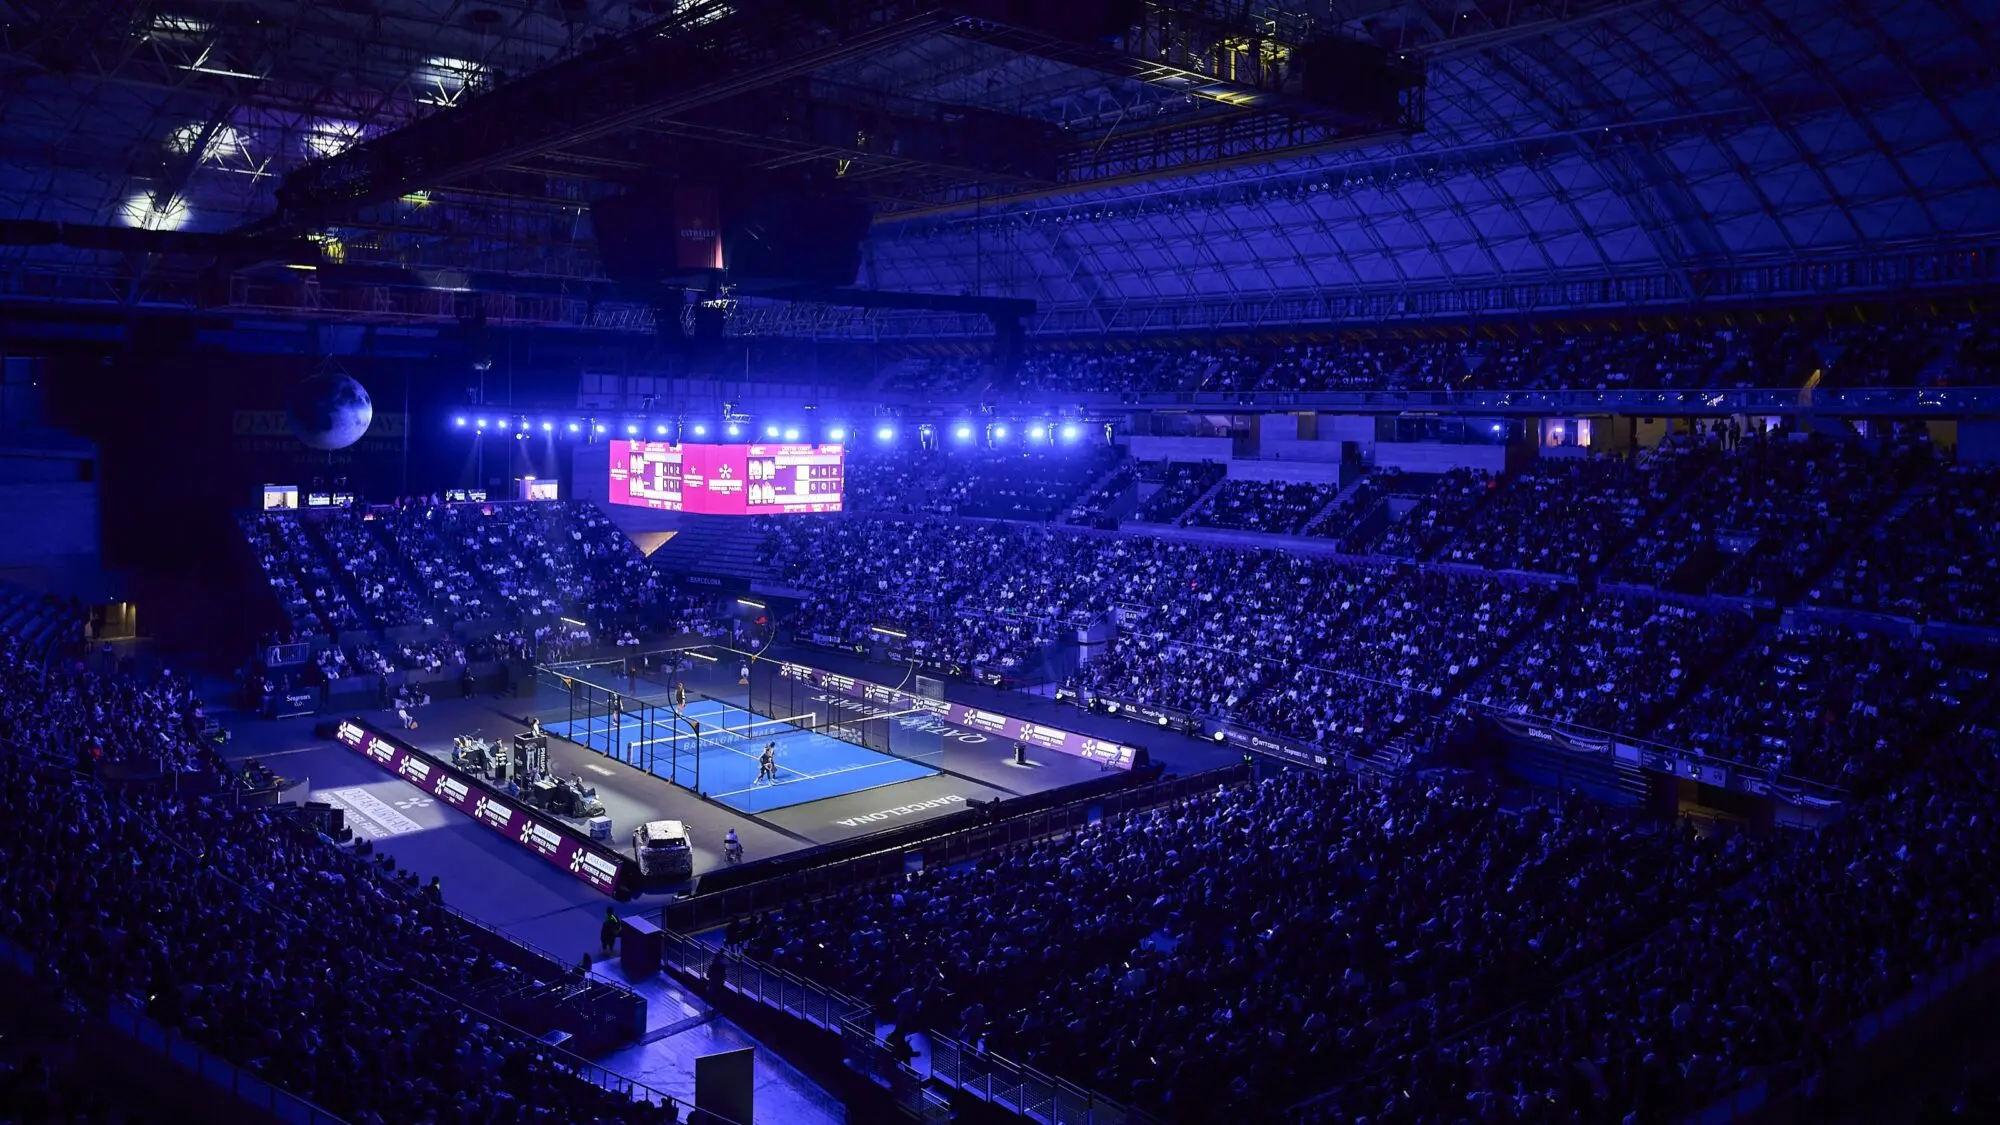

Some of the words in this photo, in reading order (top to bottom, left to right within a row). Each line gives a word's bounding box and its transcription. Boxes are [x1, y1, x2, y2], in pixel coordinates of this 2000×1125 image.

[811, 468, 816, 476] 4
[974, 718, 992, 728] PREMIER
[991, 723, 1004, 731] PADEL
[1528, 728, 1553, 741] Wilson
[836, 795, 967, 827] BARCELONA
[531, 834, 547, 847] PREMIER
[545, 842, 557, 854] PADEL
[582, 863, 600, 877] PREMIER
[599, 872, 612, 885] PADEL
